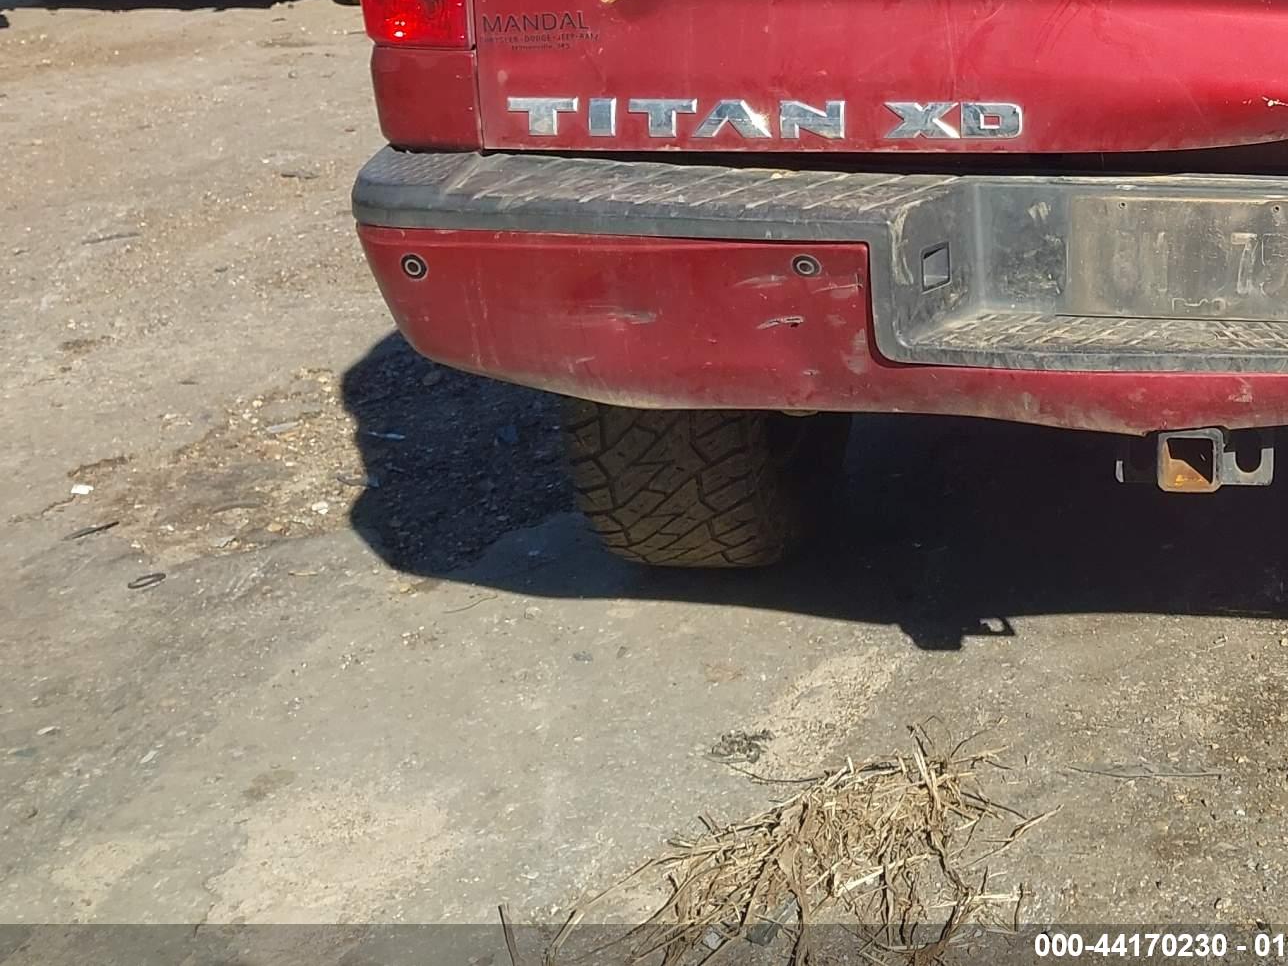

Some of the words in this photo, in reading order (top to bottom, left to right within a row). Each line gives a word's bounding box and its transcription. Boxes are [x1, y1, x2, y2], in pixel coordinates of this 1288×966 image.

[482, 12, 590, 33] MANDAL
[506, 96, 846, 139] TITAN
[884, 101, 1024, 139] XD
